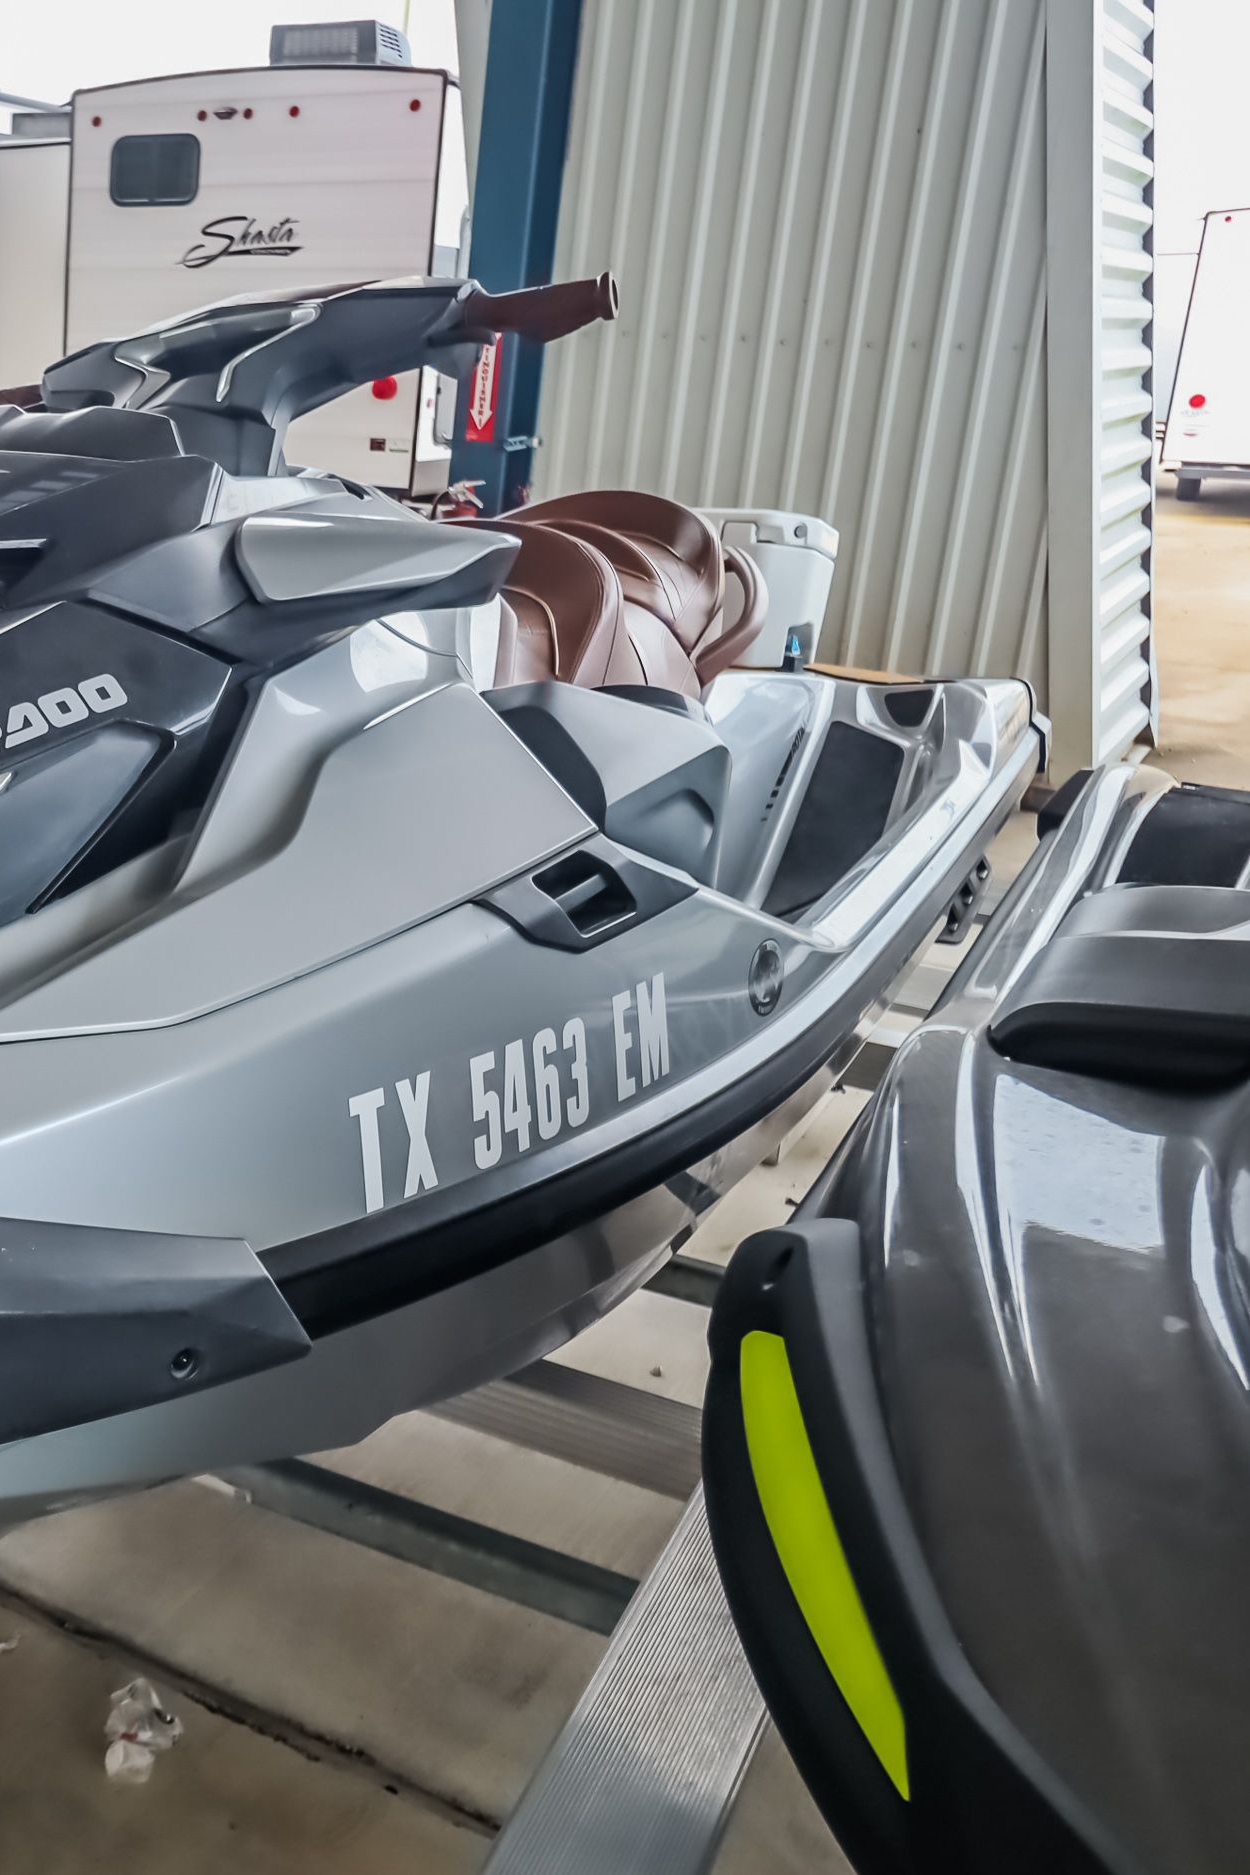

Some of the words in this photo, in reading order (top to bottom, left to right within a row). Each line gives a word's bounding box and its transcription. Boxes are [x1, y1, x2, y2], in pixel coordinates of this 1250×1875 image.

[176, 215, 300, 269] Shasta
[348, 1070, 439, 1214] TX
[469, 1017, 590, 1170] 5463
[612, 971, 670, 1102] EM
